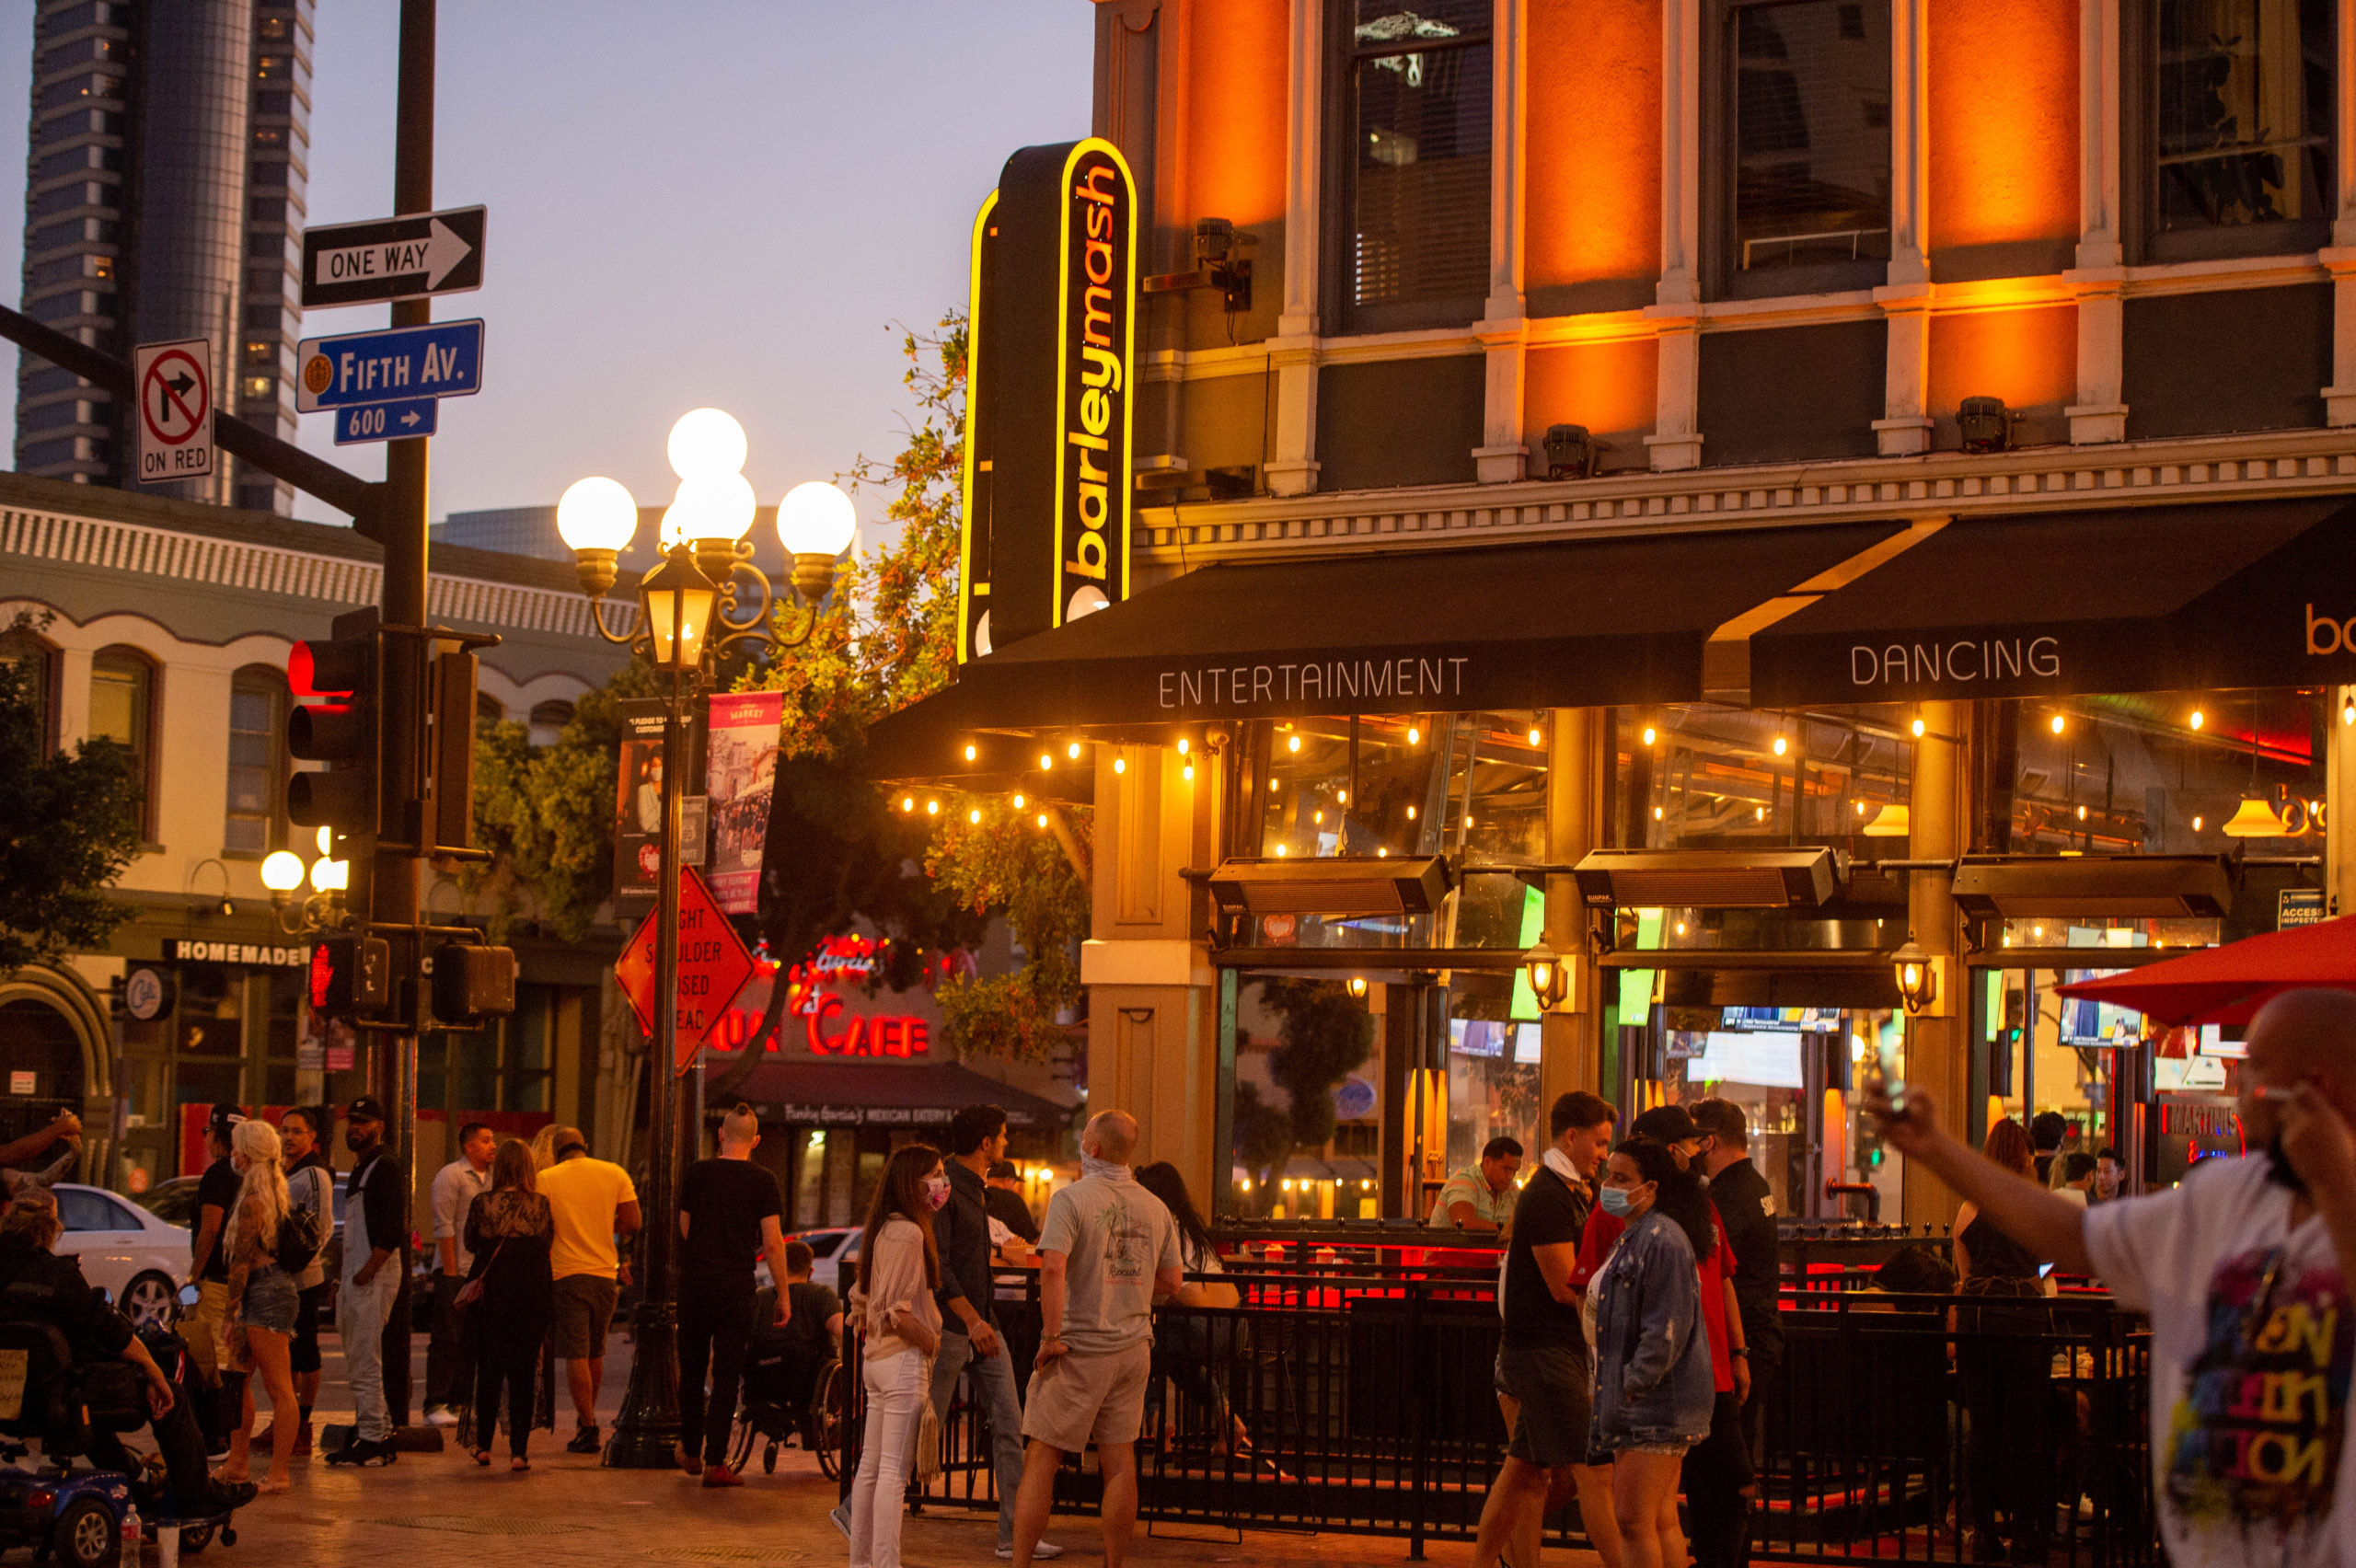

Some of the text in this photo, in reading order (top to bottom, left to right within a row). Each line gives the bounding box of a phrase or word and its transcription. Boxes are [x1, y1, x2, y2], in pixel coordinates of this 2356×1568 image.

[330, 243, 430, 278] ONE WAY
[340, 341, 465, 394] FIFTH AV.
[1065, 165, 1123, 582] barleymash
[349, 408, 386, 437] 600
[144, 447, 207, 473] ON RED
[1851, 637, 2061, 686] DANCING
[1160, 658, 1470, 709] ENTERTAINMENT
[2282, 908, 2325, 917] ACCESS
[177, 940, 300, 966] HOMEMADE
